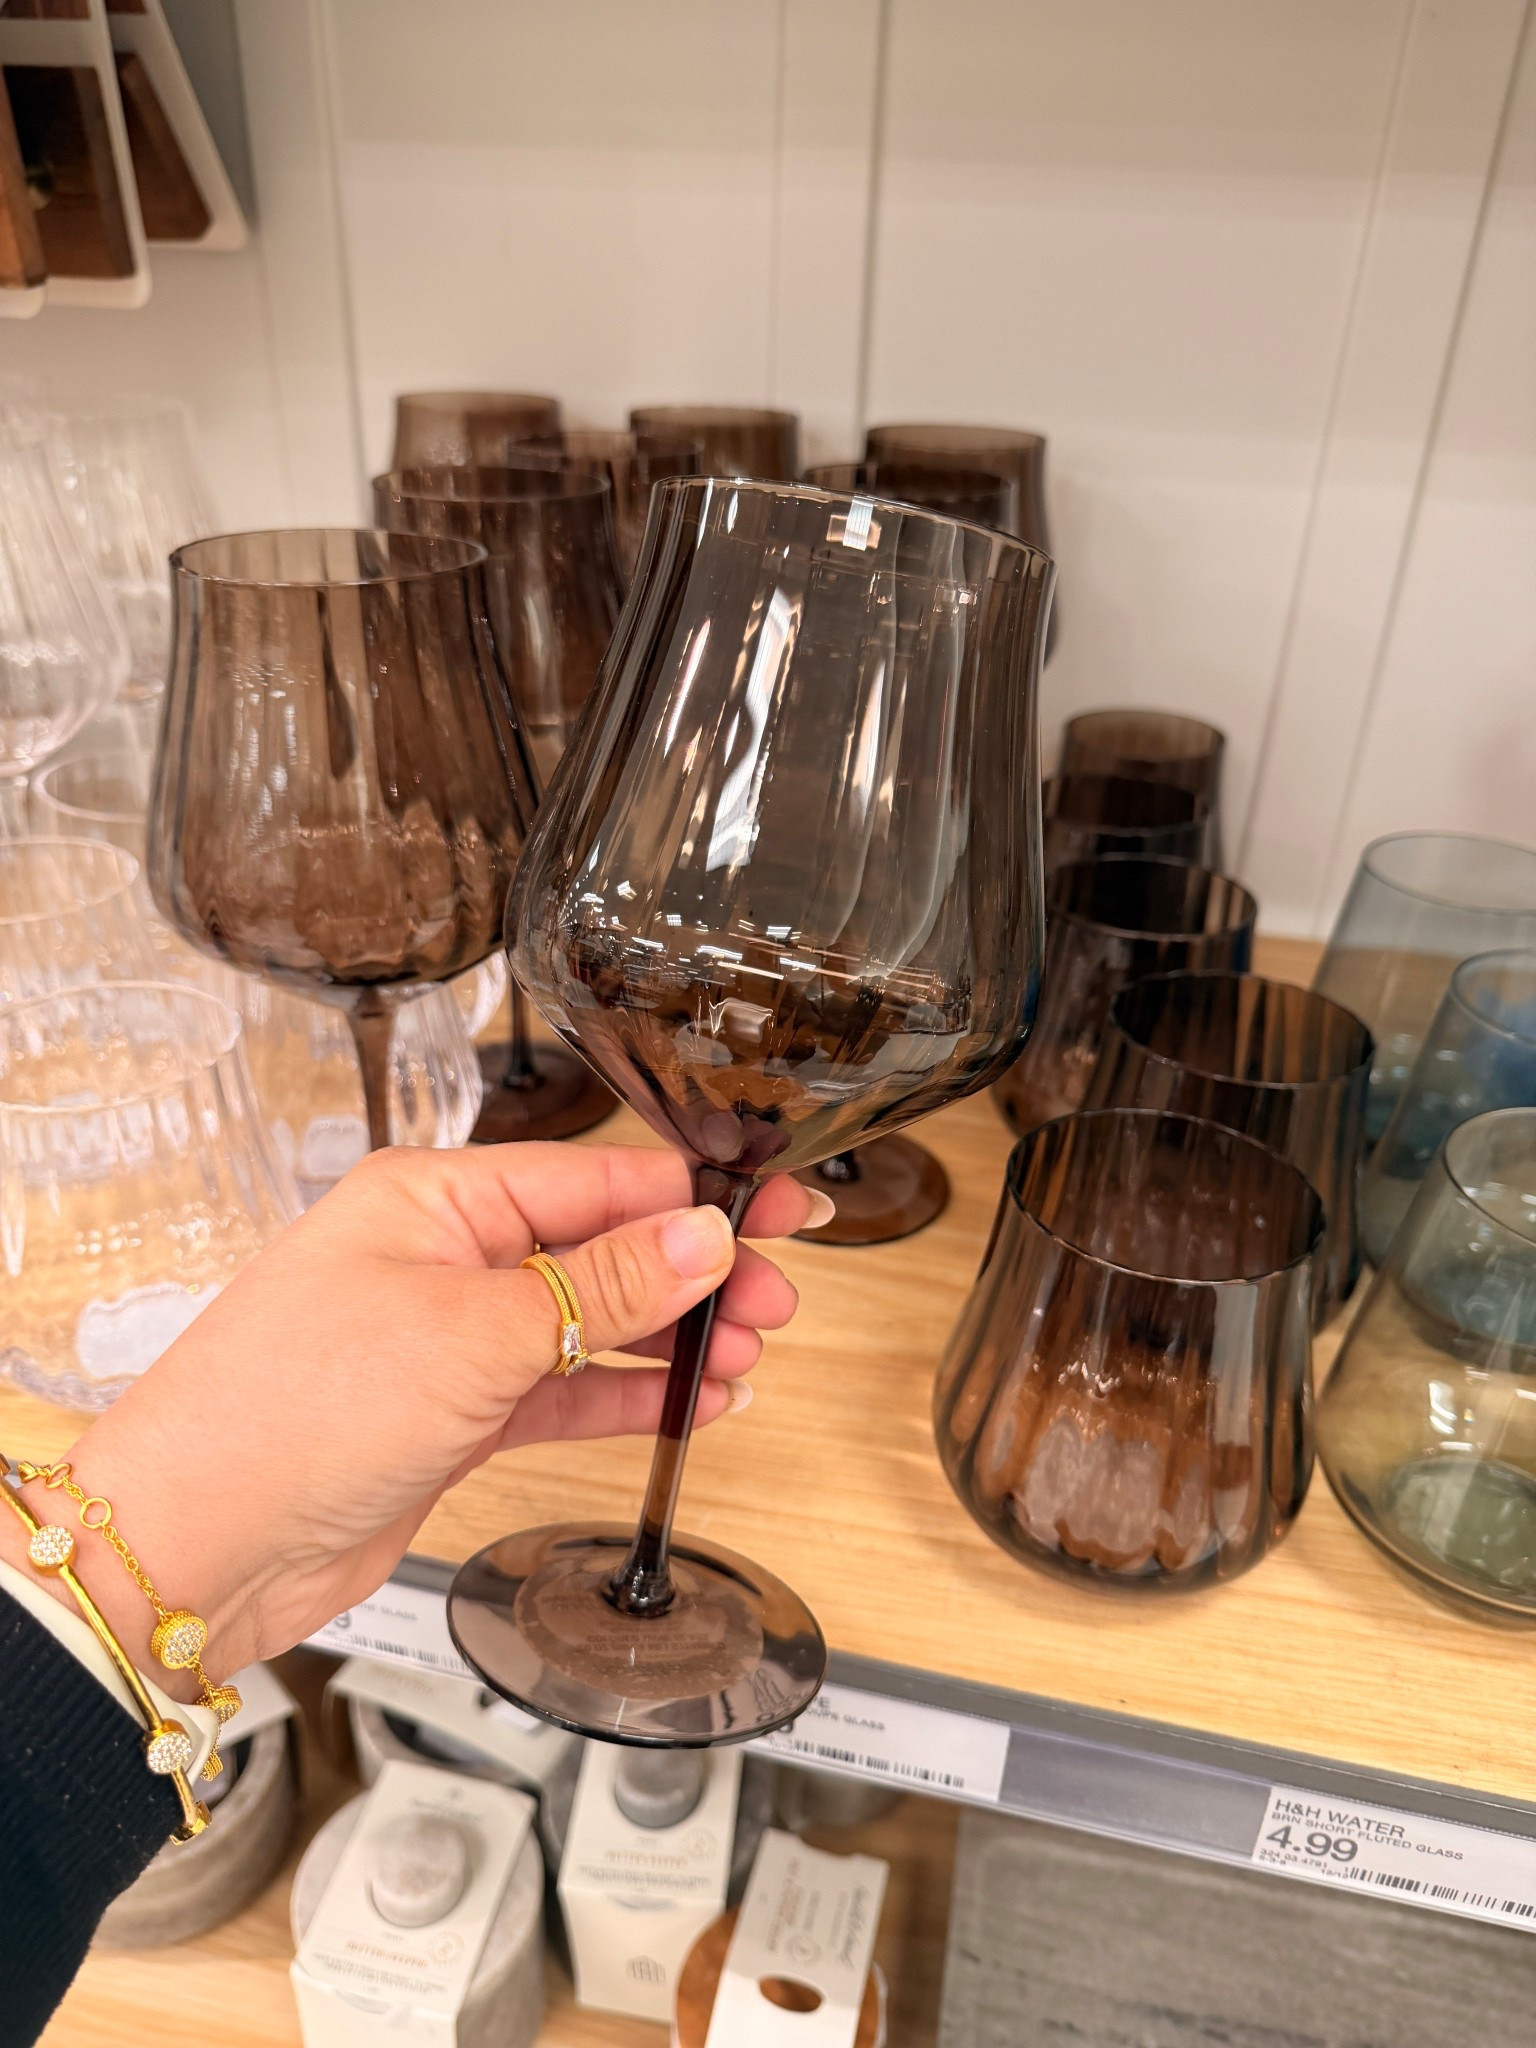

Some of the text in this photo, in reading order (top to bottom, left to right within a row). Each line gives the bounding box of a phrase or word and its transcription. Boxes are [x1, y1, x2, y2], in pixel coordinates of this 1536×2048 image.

[1272, 1812, 1463, 1860] BRN SHORT FLUTED GLASS
[1275, 1799, 1405, 1838] H&H WATER
[1266, 1825, 1358, 1862] 4.99
